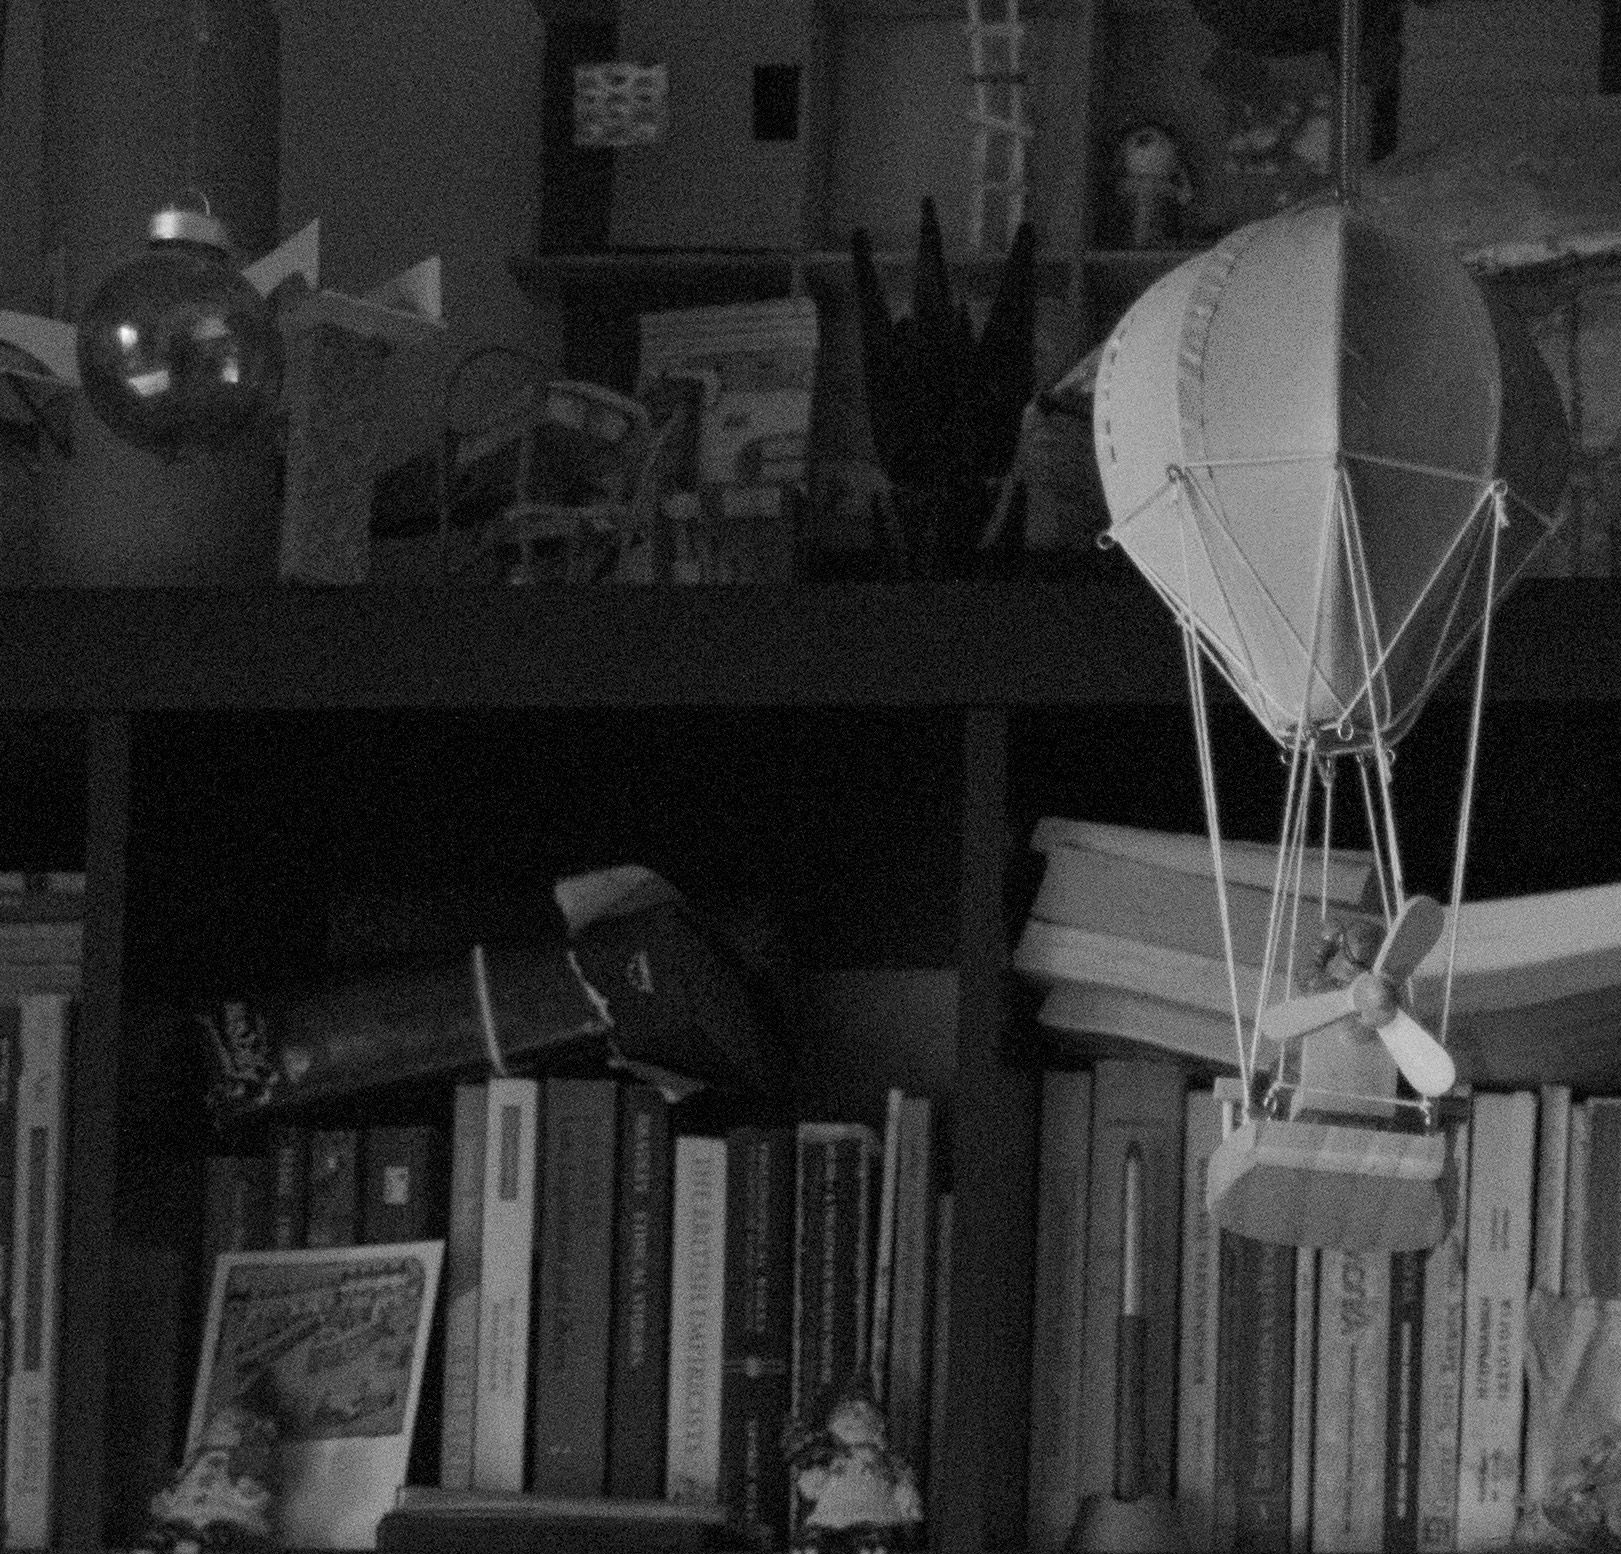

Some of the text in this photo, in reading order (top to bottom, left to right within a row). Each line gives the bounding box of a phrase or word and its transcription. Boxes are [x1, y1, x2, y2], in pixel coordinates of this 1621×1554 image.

[683, 1155, 713, 1456] THE BRITISH EMPIRICISTS
